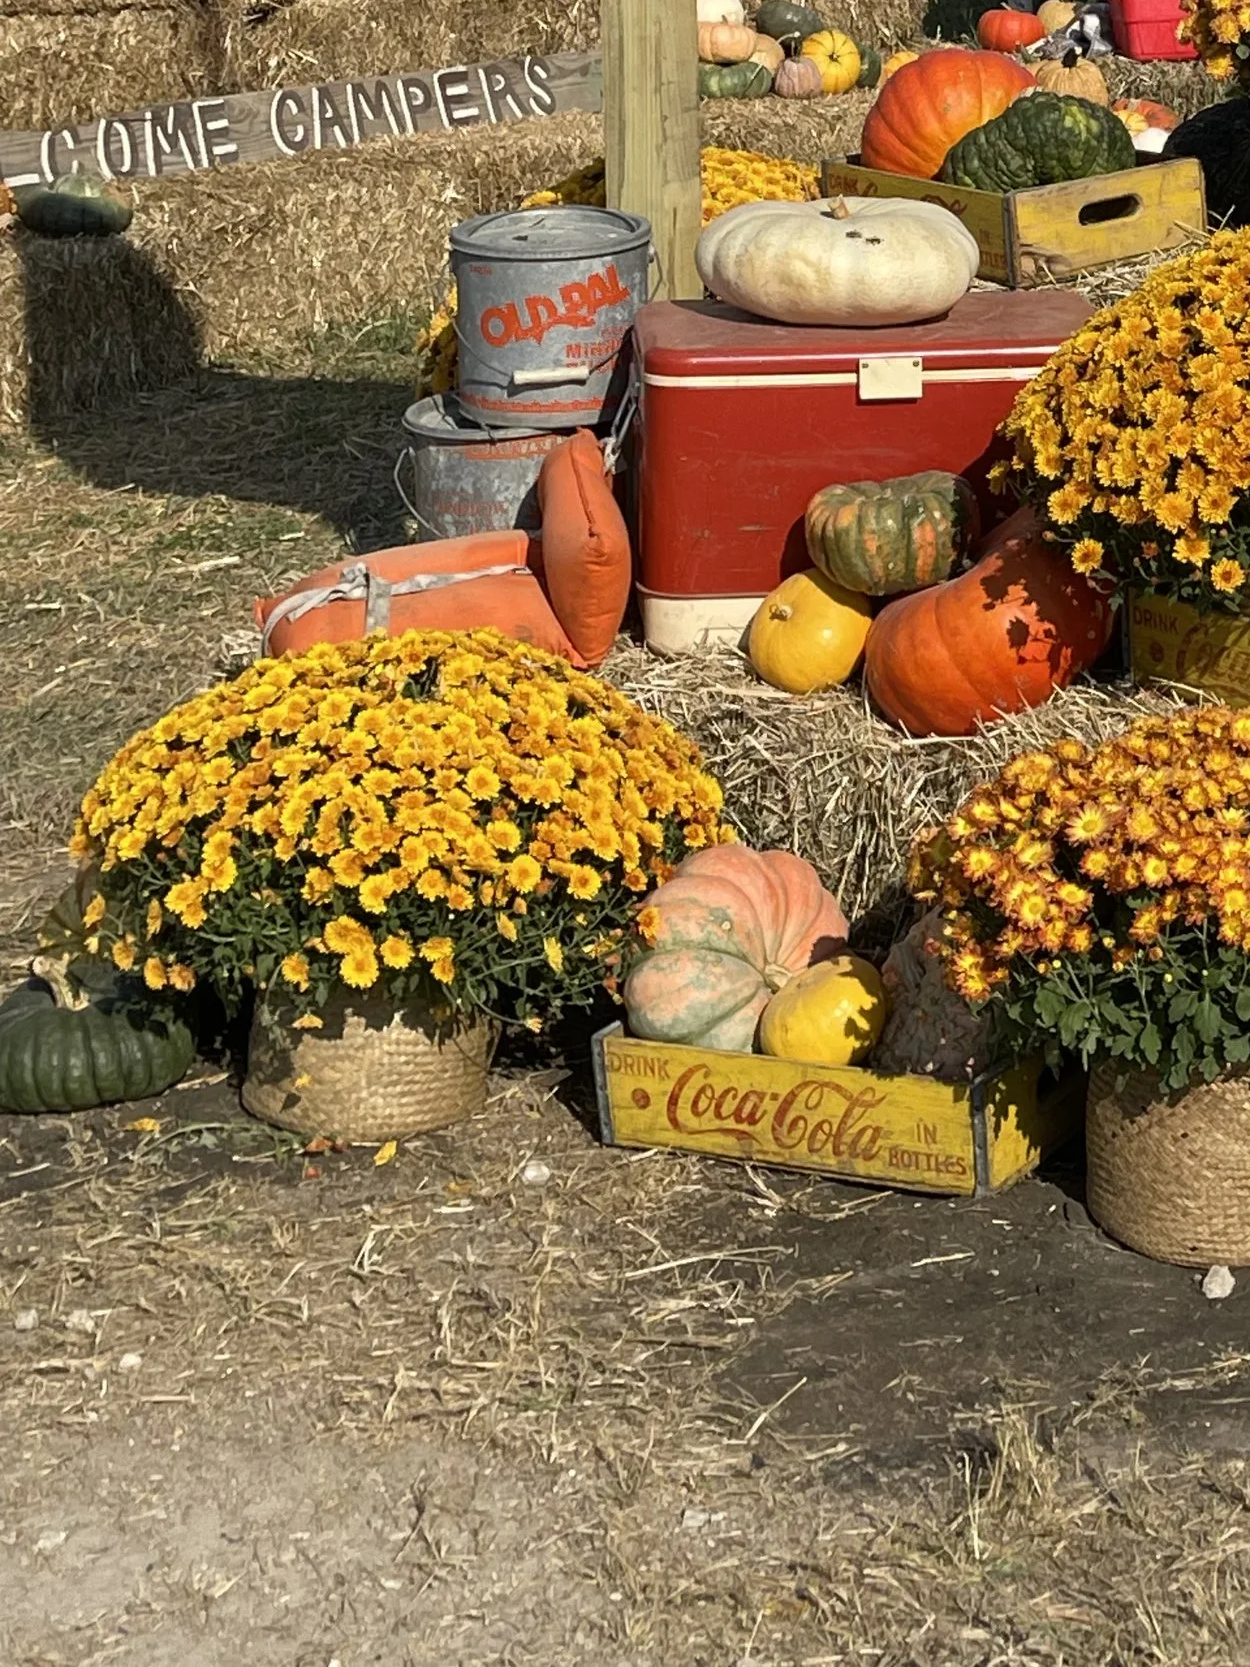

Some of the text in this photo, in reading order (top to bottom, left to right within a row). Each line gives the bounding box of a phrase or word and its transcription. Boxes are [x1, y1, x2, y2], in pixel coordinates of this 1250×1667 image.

[4, 55, 557, 184] COME CAMPERS
[480, 264, 631, 348] OLD PAL
[1132, 605, 1179, 632] DRINK
[608, 1051, 671, 1081] DRINK
[666, 1062, 888, 1162] Coca-Cola
[915, 1122, 938, 1146] IN
[887, 1147, 967, 1177] BOTTLES
